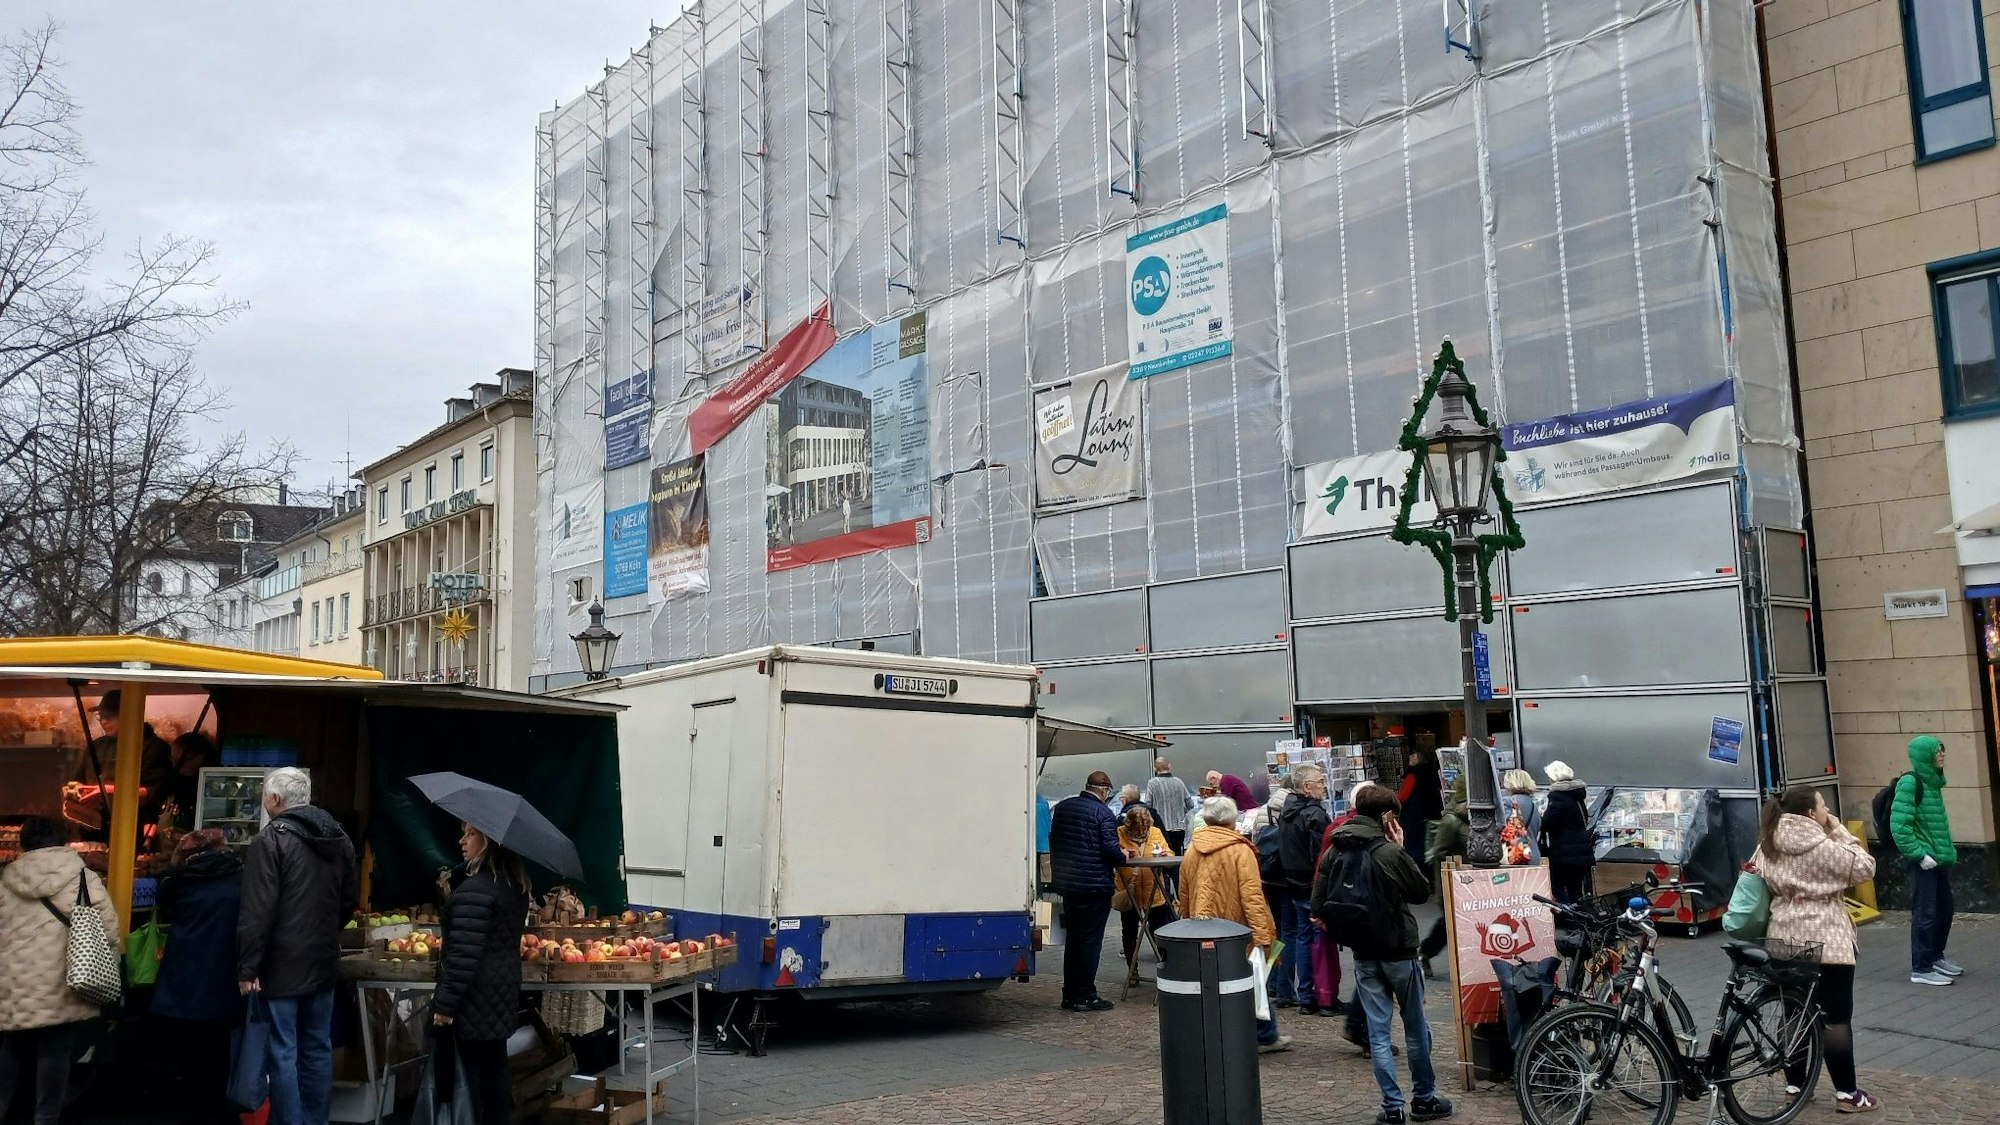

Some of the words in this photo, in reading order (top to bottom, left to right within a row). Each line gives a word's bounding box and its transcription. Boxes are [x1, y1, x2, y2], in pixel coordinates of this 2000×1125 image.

[900, 323, 925, 339] MARKT
[1513, 421, 1566, 445] Buchliebe
[1569, 423, 1585, 435] ist
[1585, 417, 1610, 433] hier
[1612, 402, 1670, 427] zuhause!
[1553, 459, 1568, 470] Wir
[1569, 456, 1583, 469] sind
[1583, 455, 1594, 466] für
[1620, 447, 1640, 459] Auch
[1697, 450, 1731, 466] Thalia
[1587, 465, 1600, 476] des
[623, 508, 648, 529] MELIK
[432, 573, 481, 589] HOTEL
[892, 677, 904, 690] SU
[923, 681, 945, 694] 5744
[1511, 905, 1543, 920] PARTY
